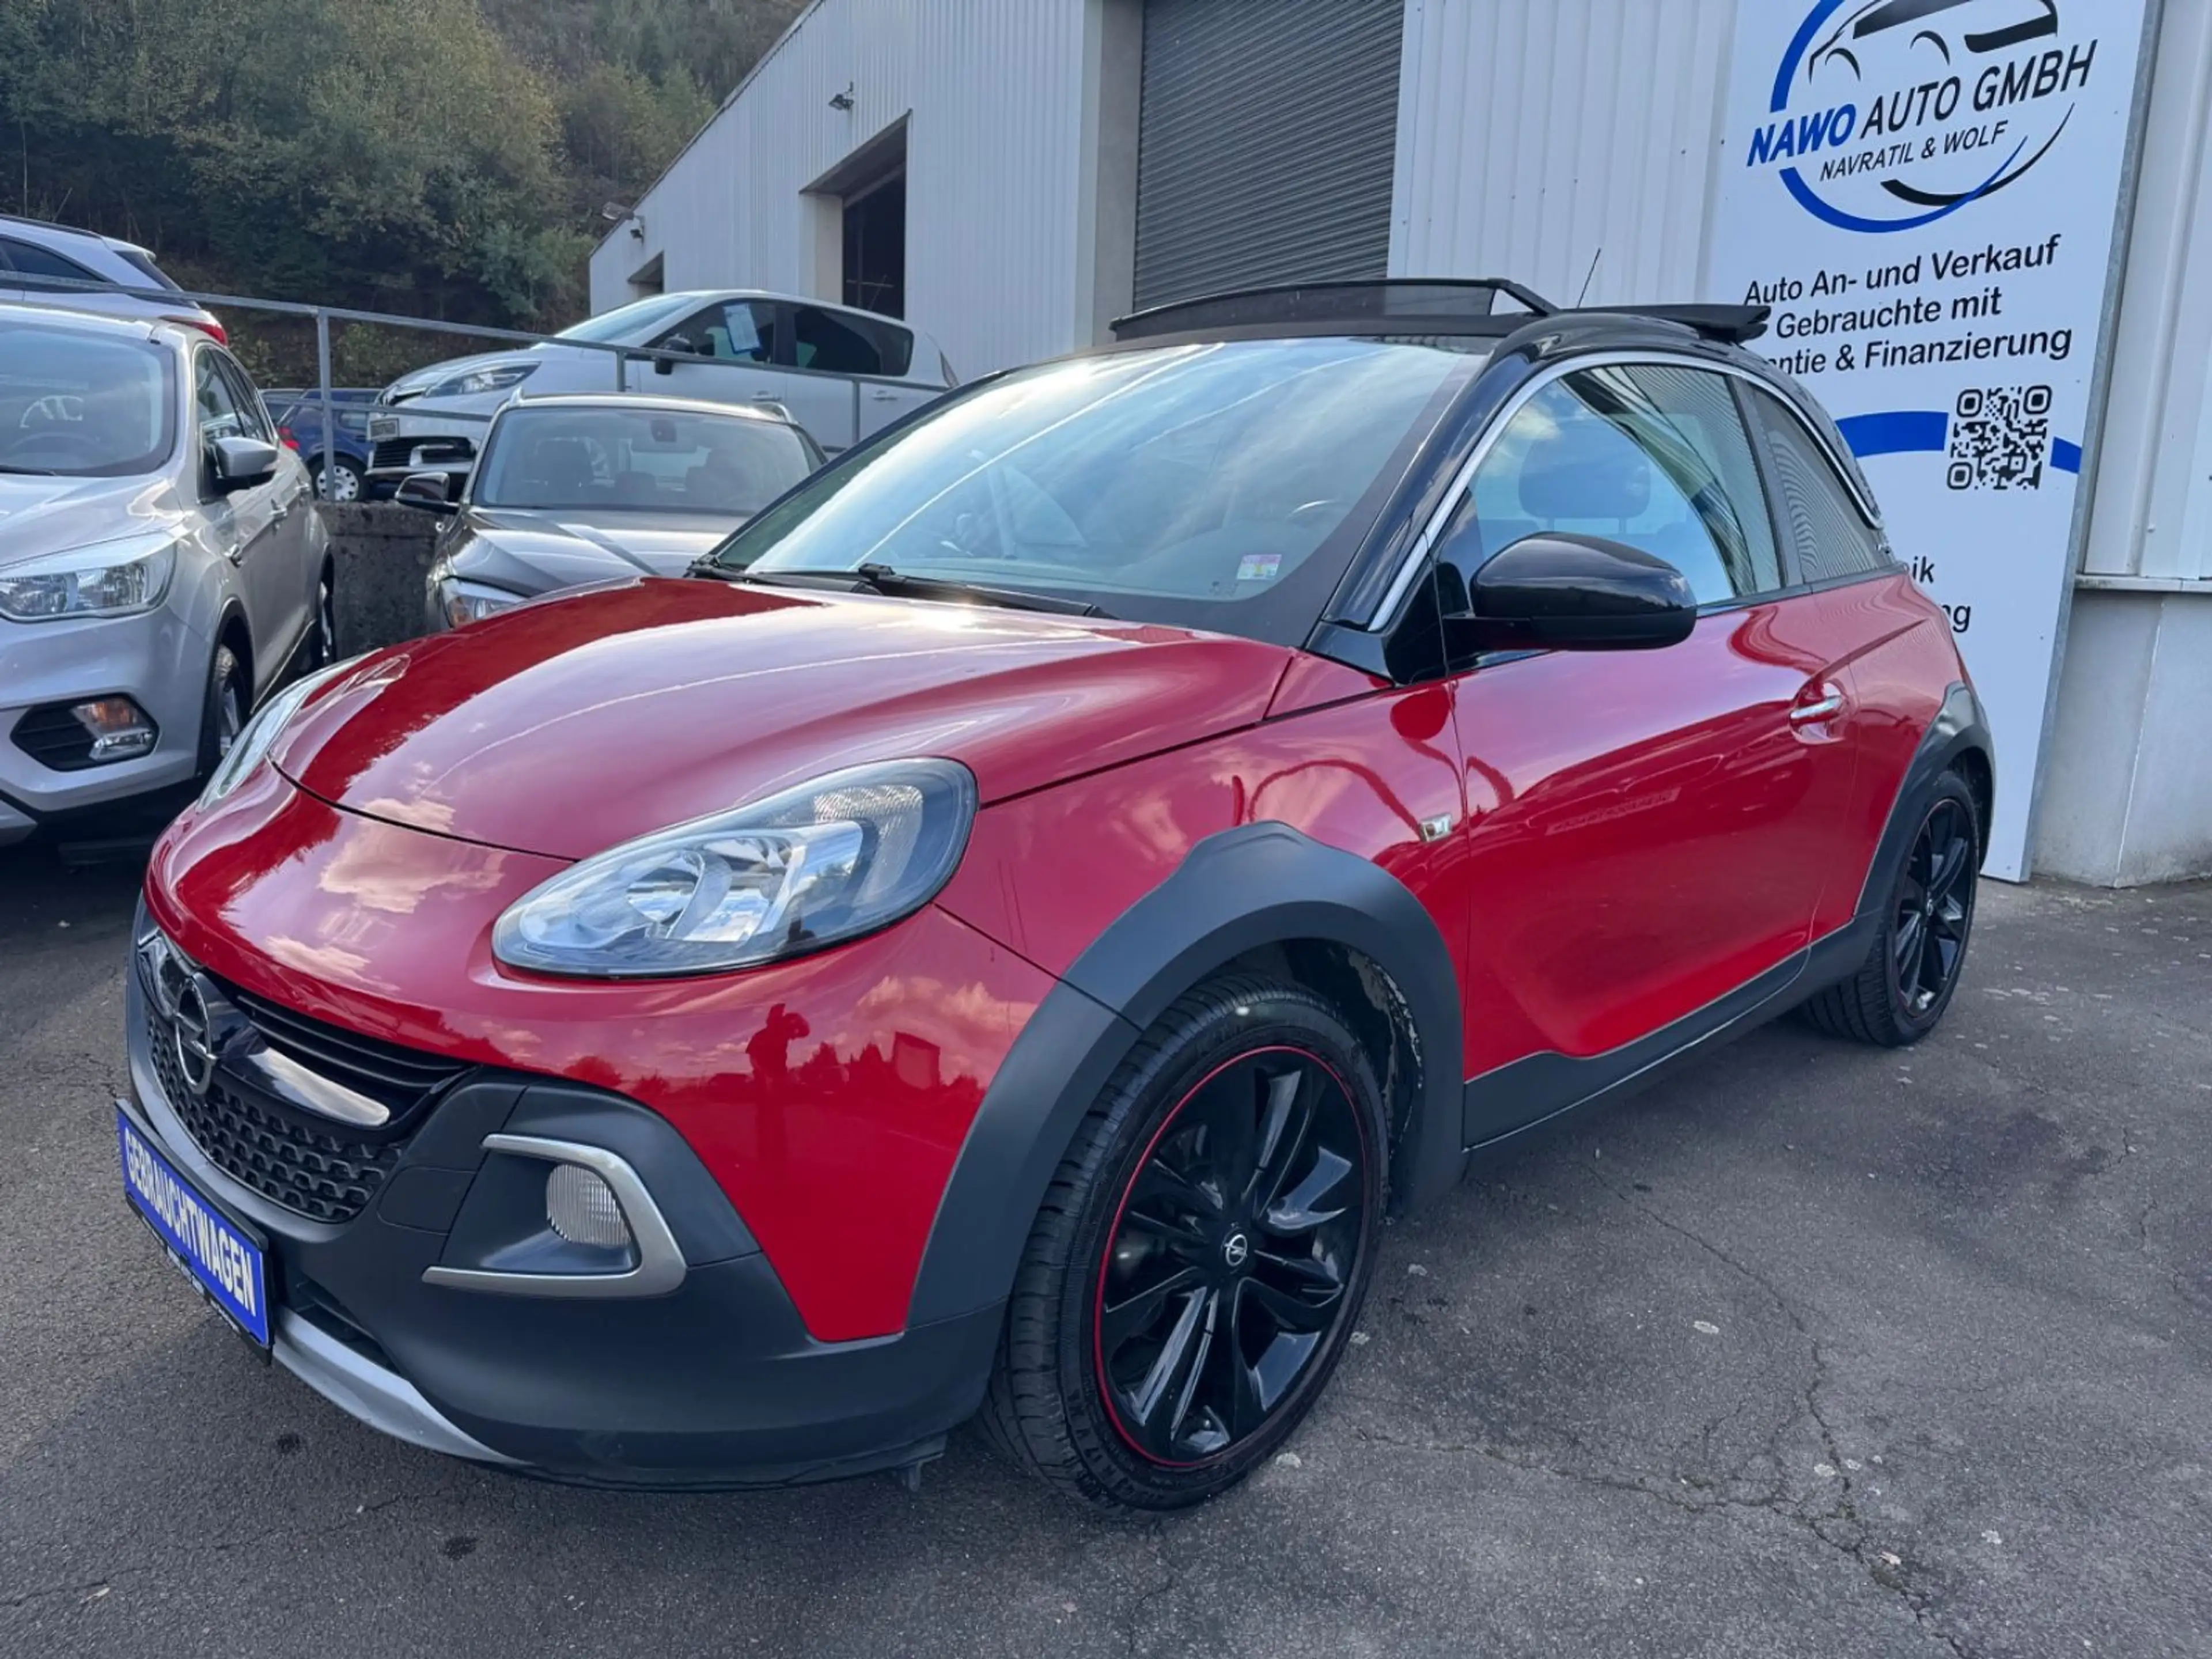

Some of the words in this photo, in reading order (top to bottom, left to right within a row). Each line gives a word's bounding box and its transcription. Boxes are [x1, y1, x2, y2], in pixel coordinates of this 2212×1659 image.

[1746, 103, 1856, 167] NAWO
[1859, 76, 1961, 139] AUTO
[1972, 39, 2098, 112] GMBH
[1819, 142, 1914, 181] NAVRATIL
[1921, 137, 1937, 159] &
[1943, 120, 2009, 154] WOLF
[1744, 276, 1803, 305] Auto
[1810, 270, 1858, 297] An-
[1866, 255, 1922, 290] und
[1931, 233, 2062, 280] Verkauf
[1776, 297, 1941, 339] Gebrauchte
[1950, 286, 2002, 320] mit
[1835, 344, 1855, 371] &
[1864, 329, 2073, 369] Finanzierung
[1911, 555, 1935, 584] ik
[124, 1126, 257, 1317] GEBRAUCHTWAGEN
